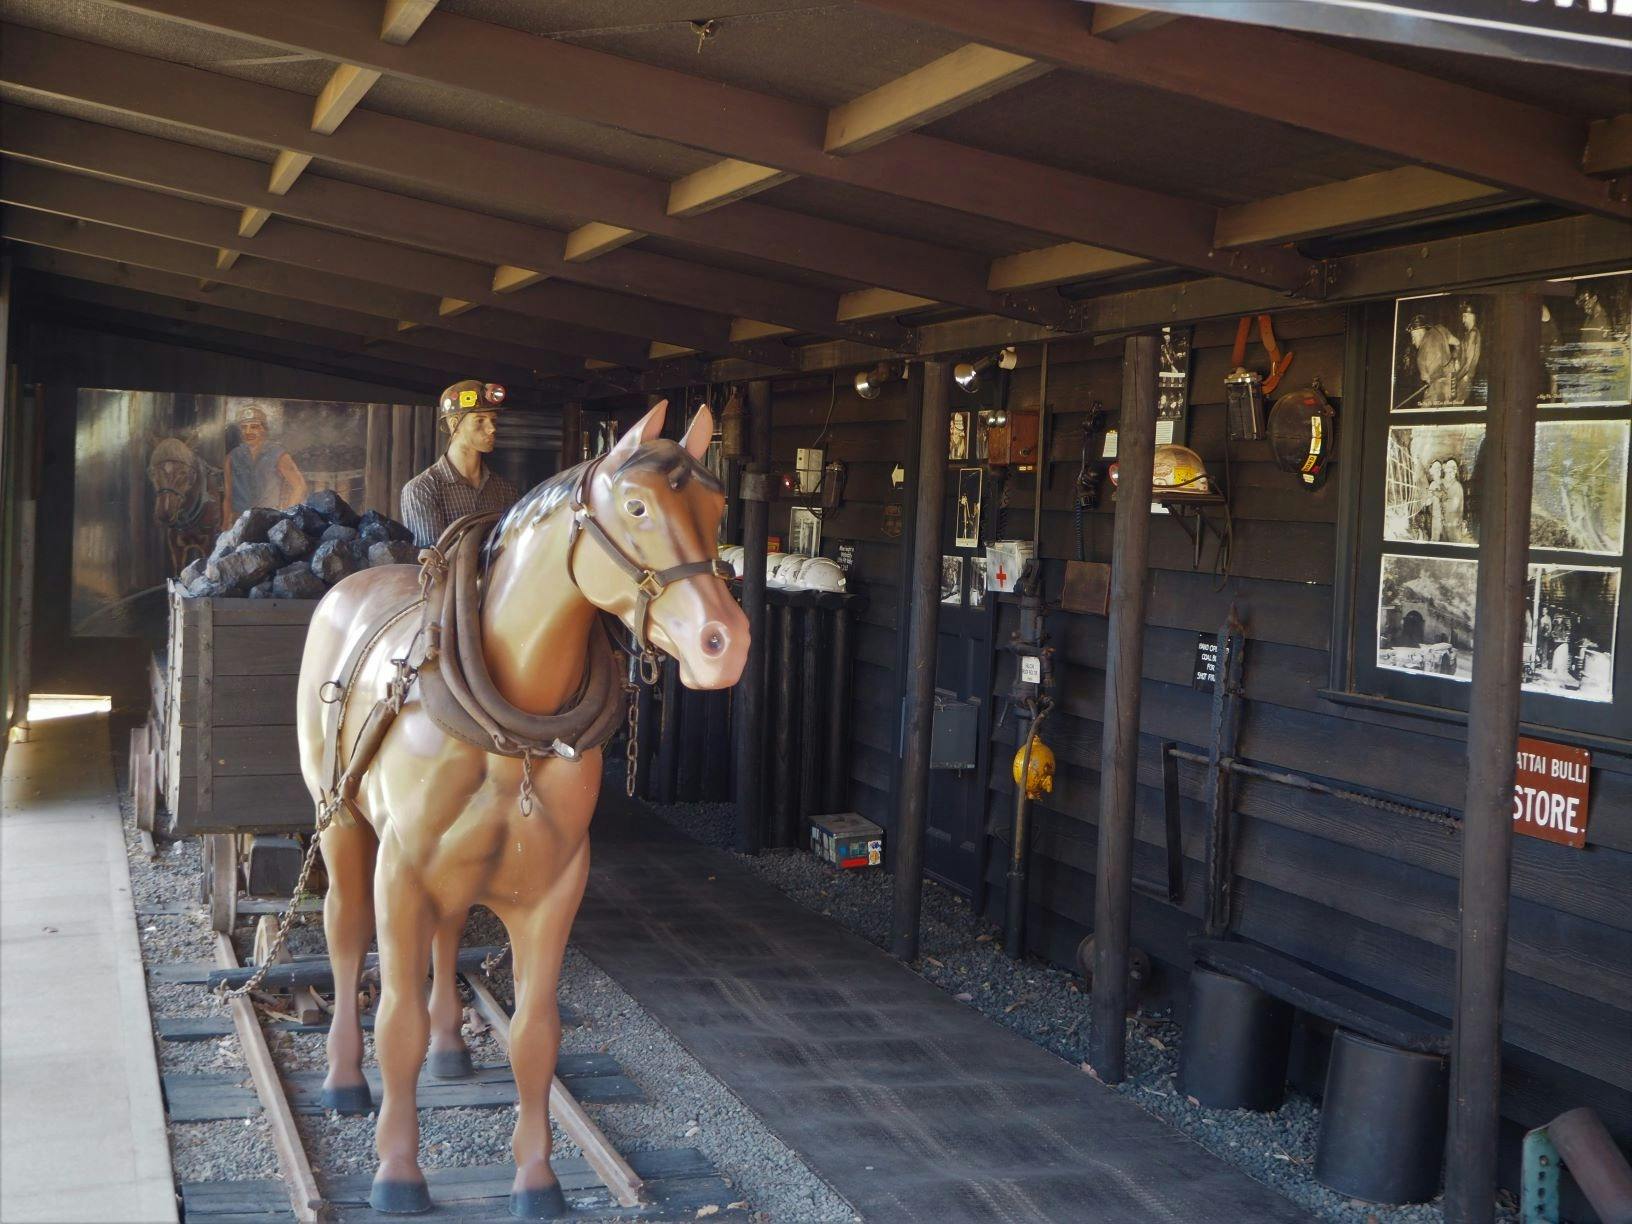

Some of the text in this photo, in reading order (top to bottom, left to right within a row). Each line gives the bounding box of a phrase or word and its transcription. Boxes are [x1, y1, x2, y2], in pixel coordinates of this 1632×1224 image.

[1207, 663, 1215, 671] FOR
[1516, 752, 1587, 784] ATTAI BULLI
[1513, 785, 1580, 834] STORE
